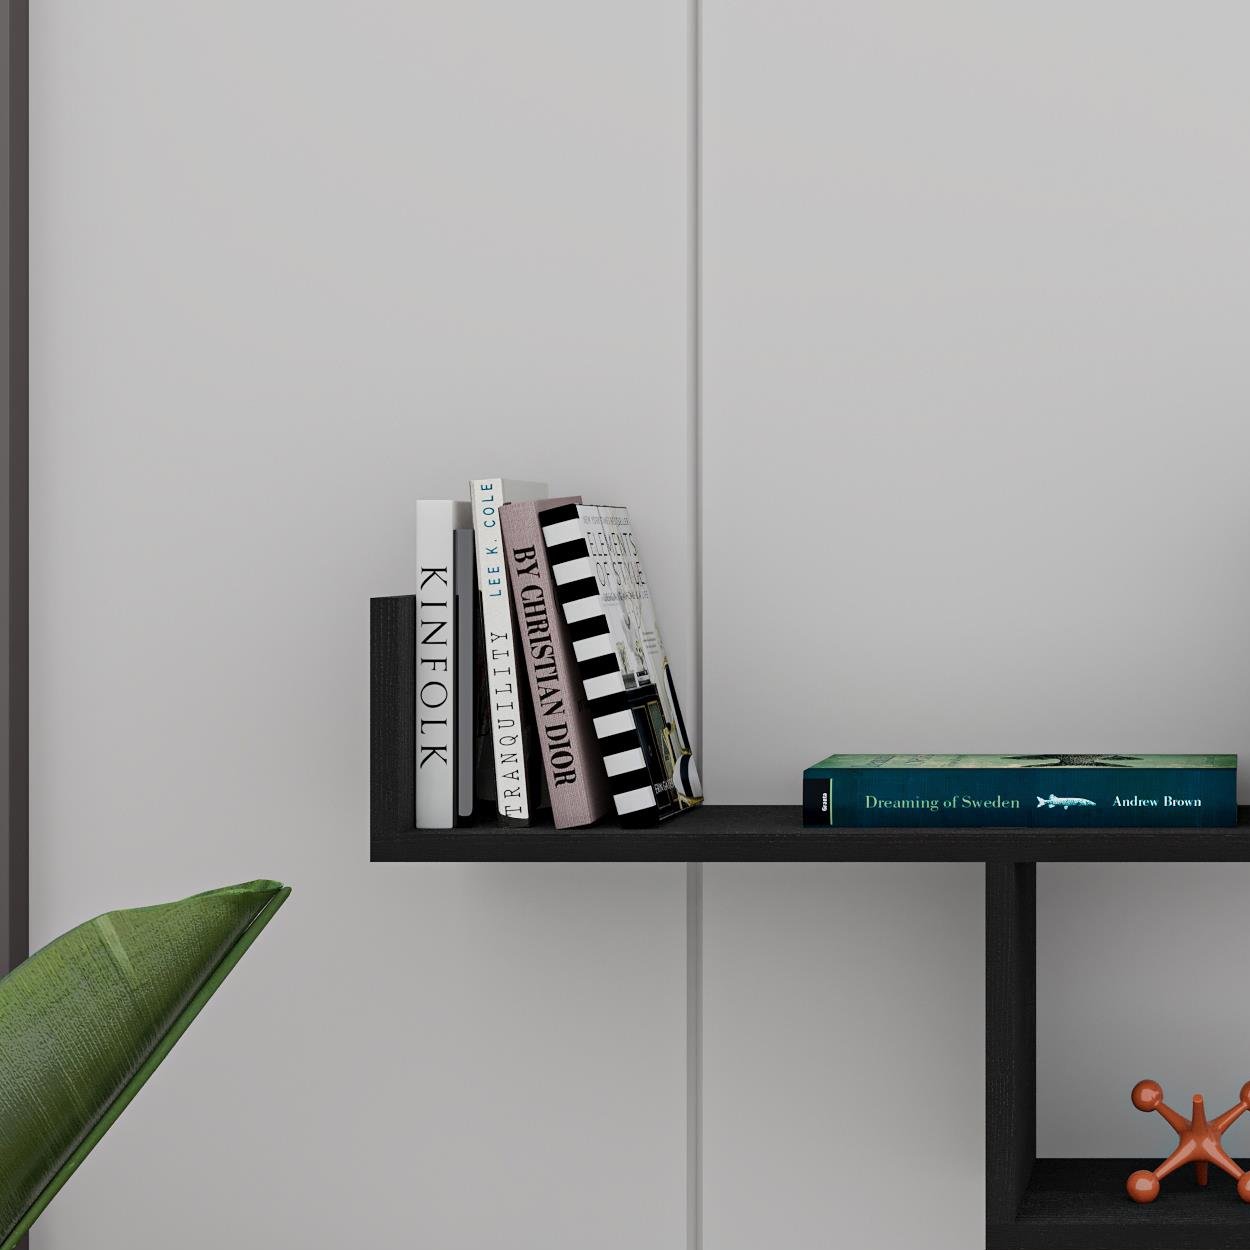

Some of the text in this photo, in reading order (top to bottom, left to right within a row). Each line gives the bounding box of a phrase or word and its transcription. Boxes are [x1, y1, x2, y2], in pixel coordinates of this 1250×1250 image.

[480, 483, 496, 528] COLE
[488, 566, 502, 597] LEE
[420, 566, 448, 768] KINFOLK
[513, 544, 577, 788] BY CHRISTIAN DIOR
[490, 632, 522, 817] TRANQUILITY
[866, 795, 1020, 812] Dreaming of Sweden
[1112, 795, 1202, 807] Andrew Brown
